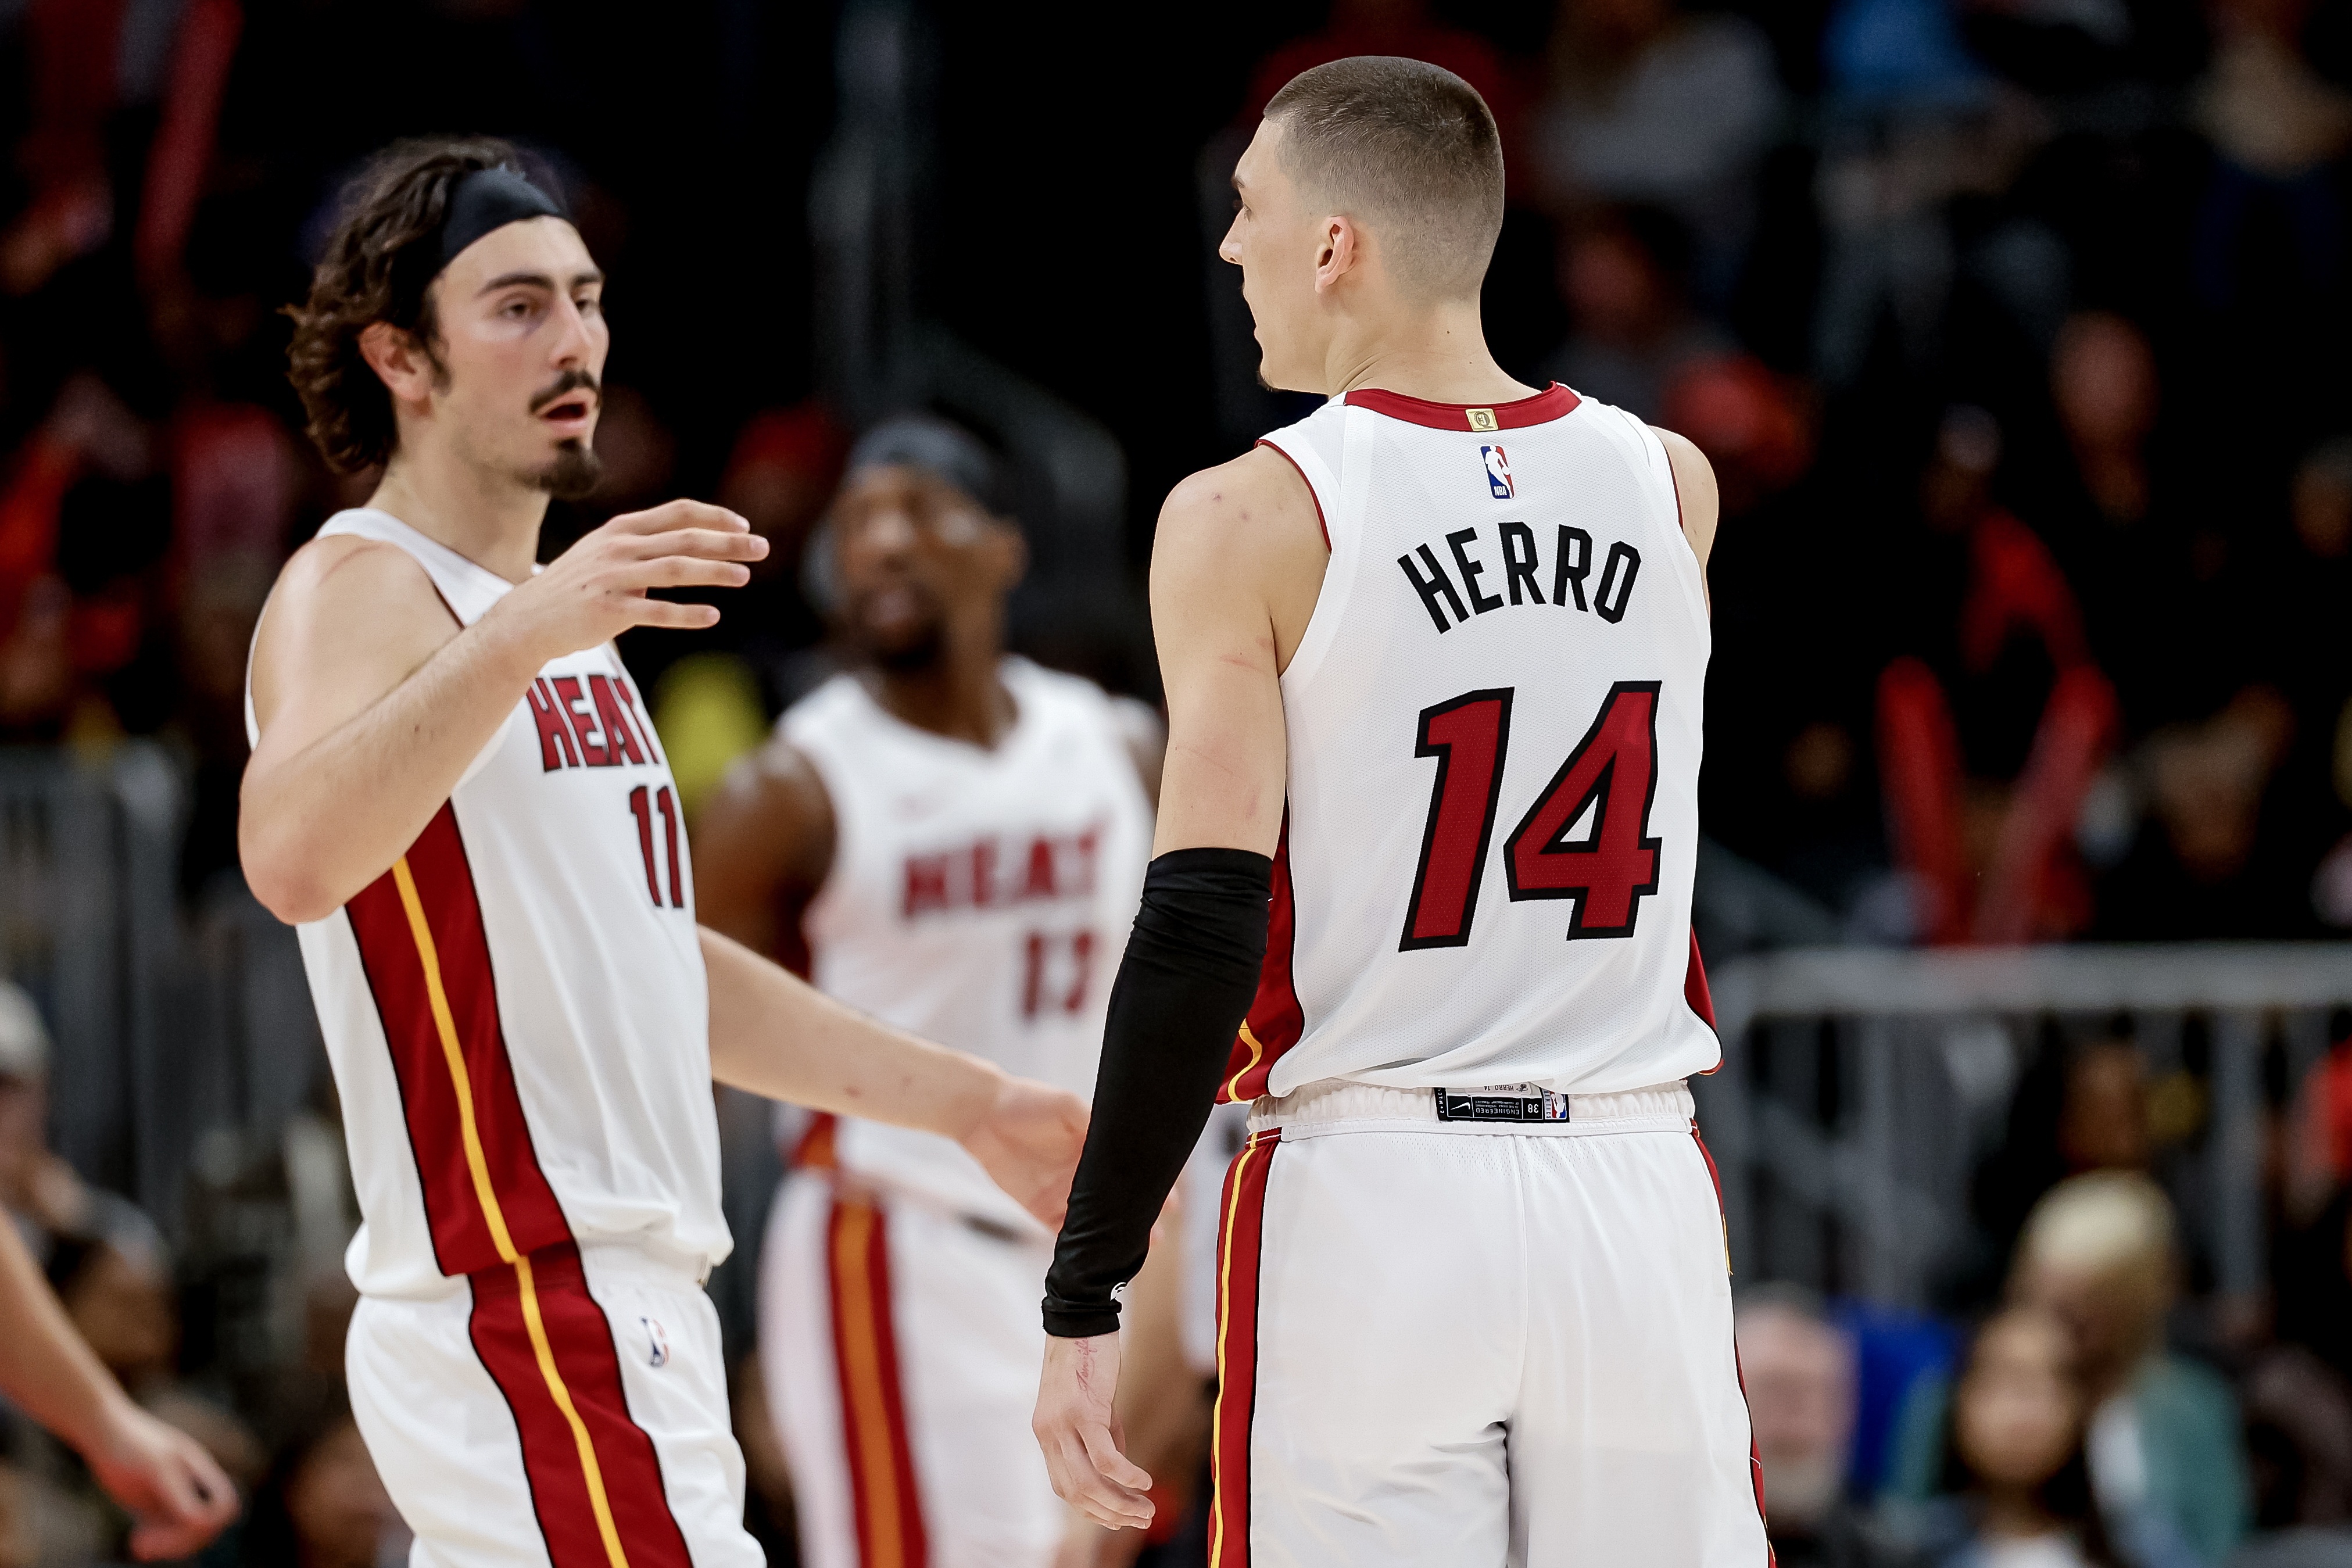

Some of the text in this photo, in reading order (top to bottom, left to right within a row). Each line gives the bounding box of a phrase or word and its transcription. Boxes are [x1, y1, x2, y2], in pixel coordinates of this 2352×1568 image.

[1494, 486, 1507, 496] NBA
[1397, 521, 1641, 635] HERRO
[629, 785, 683, 908] 11
[1398, 680, 1663, 953] 14
[1527, 1104, 1539, 1114] 38
